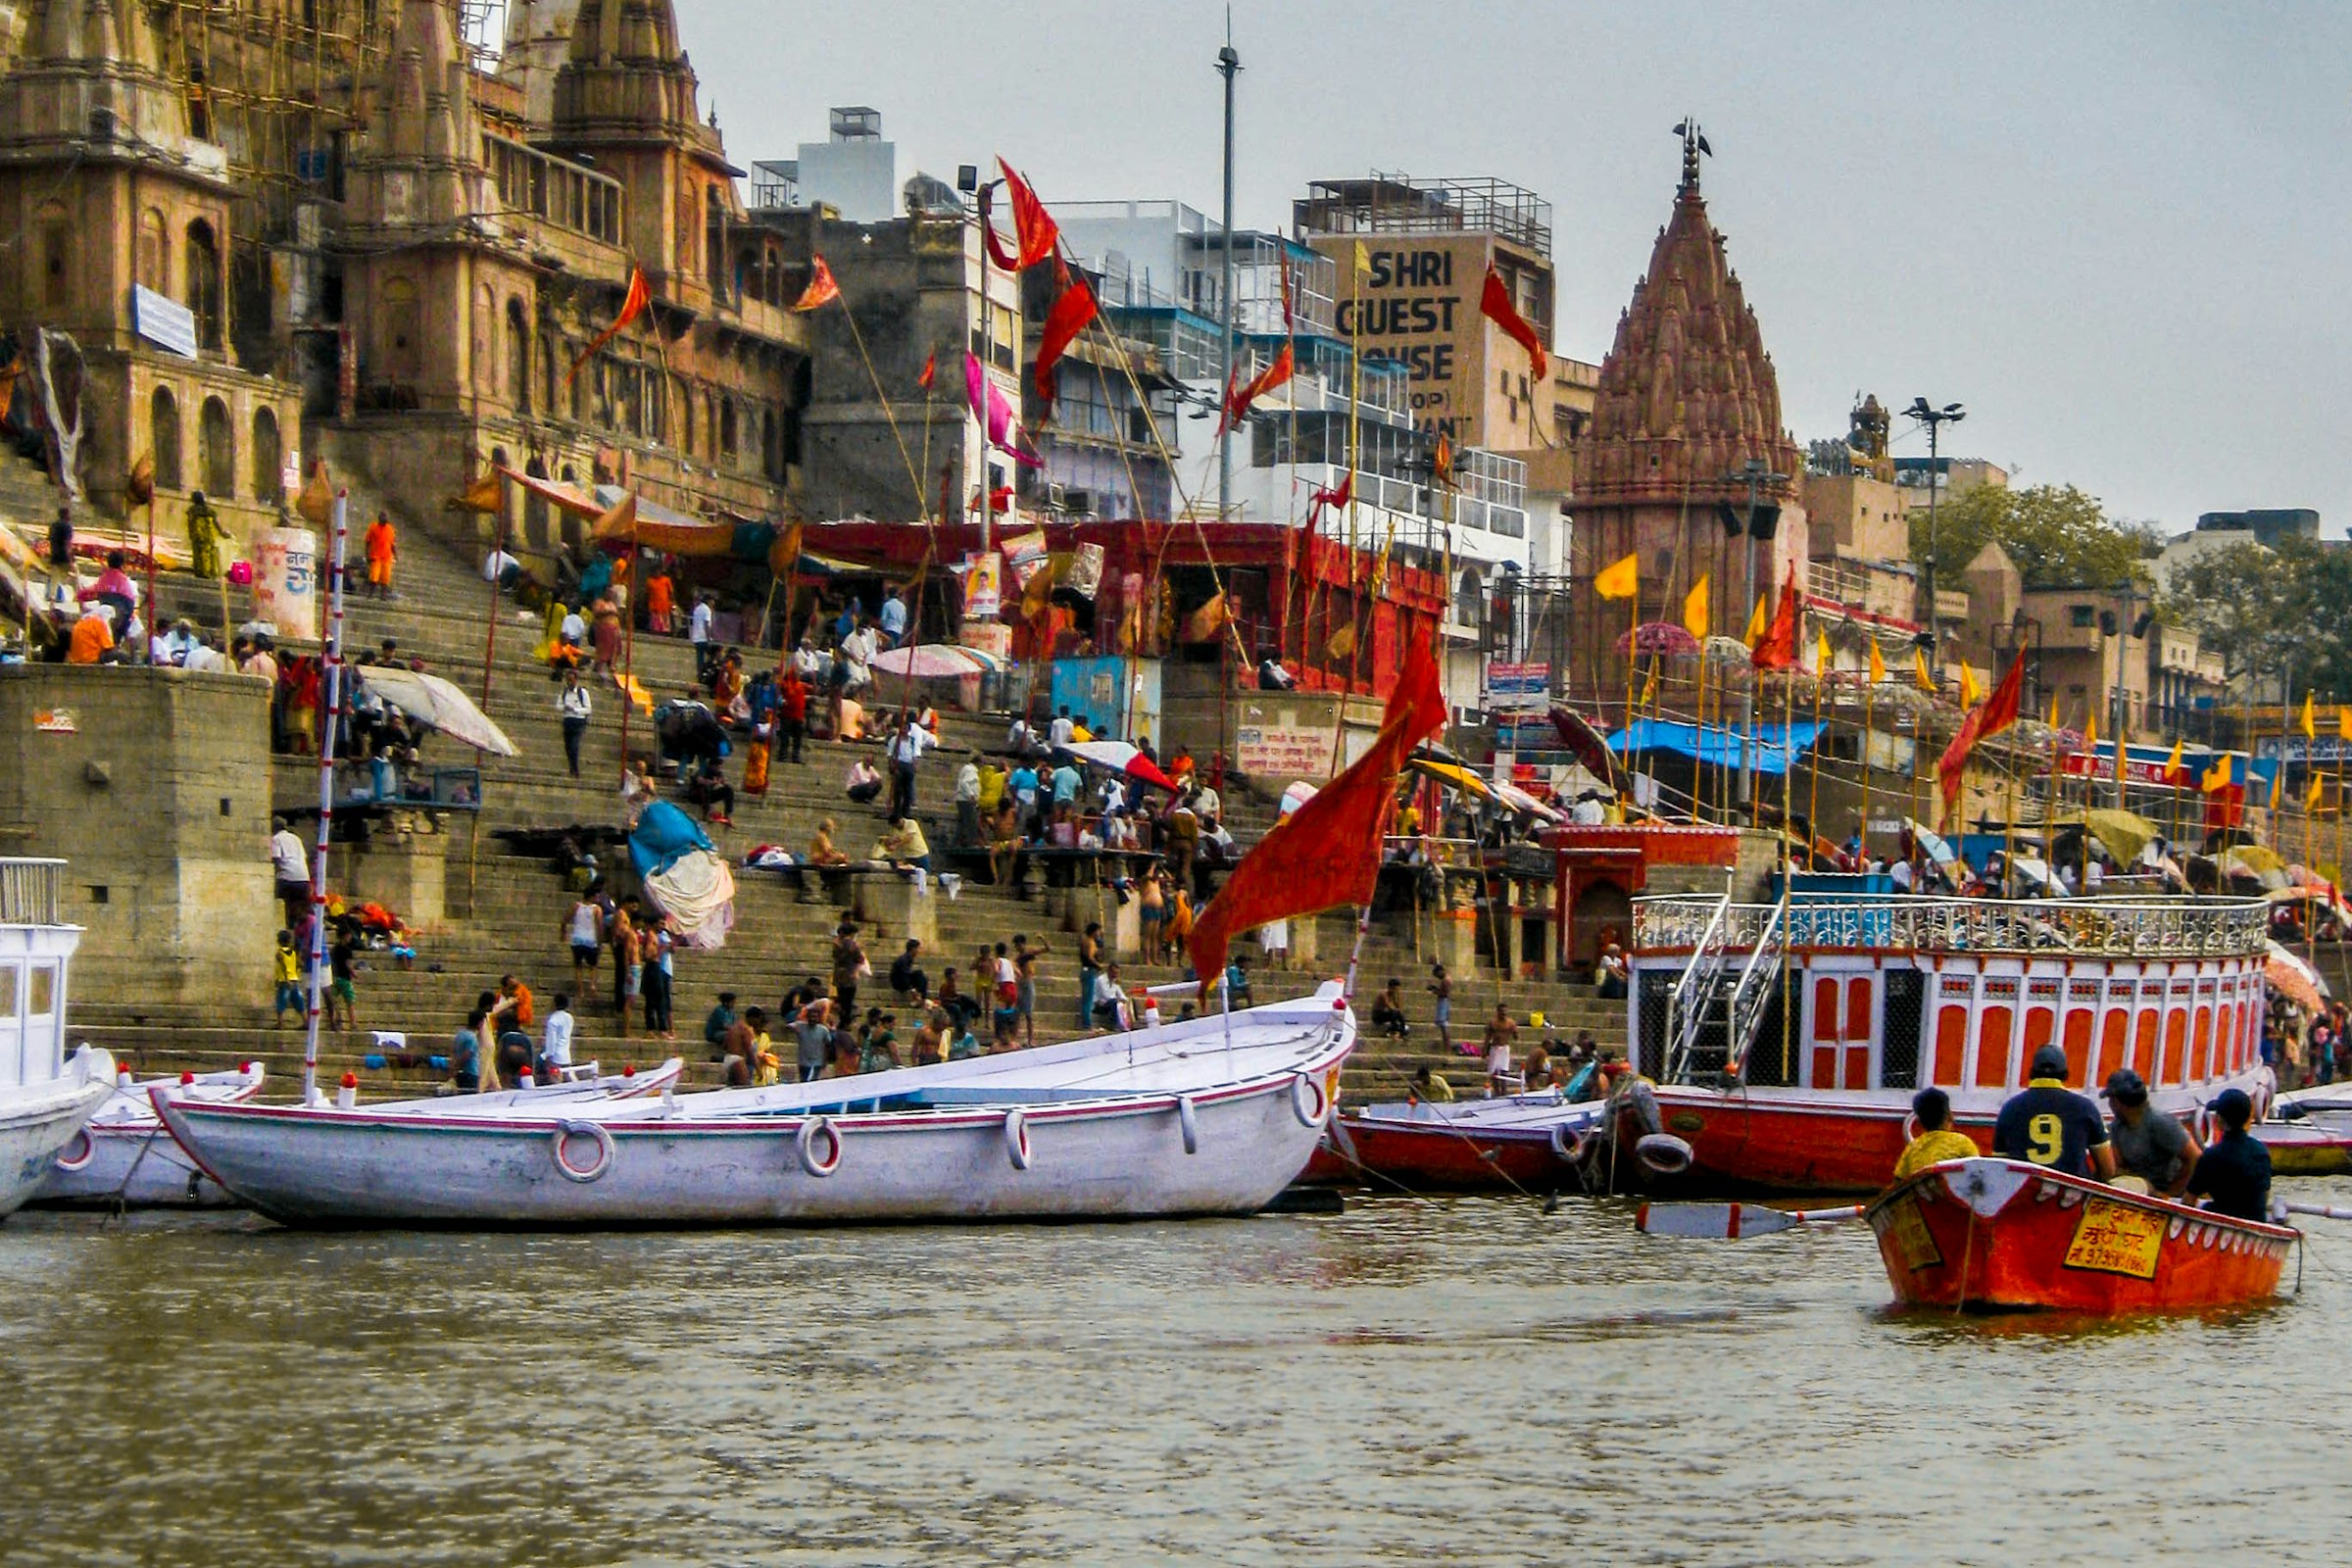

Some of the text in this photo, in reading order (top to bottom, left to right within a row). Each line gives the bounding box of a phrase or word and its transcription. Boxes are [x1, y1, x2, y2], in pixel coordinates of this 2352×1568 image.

[1369, 251, 1451, 288] SHRI
[1335, 296, 1460, 336] GUEST
[2027, 1113, 2062, 1164] 9
